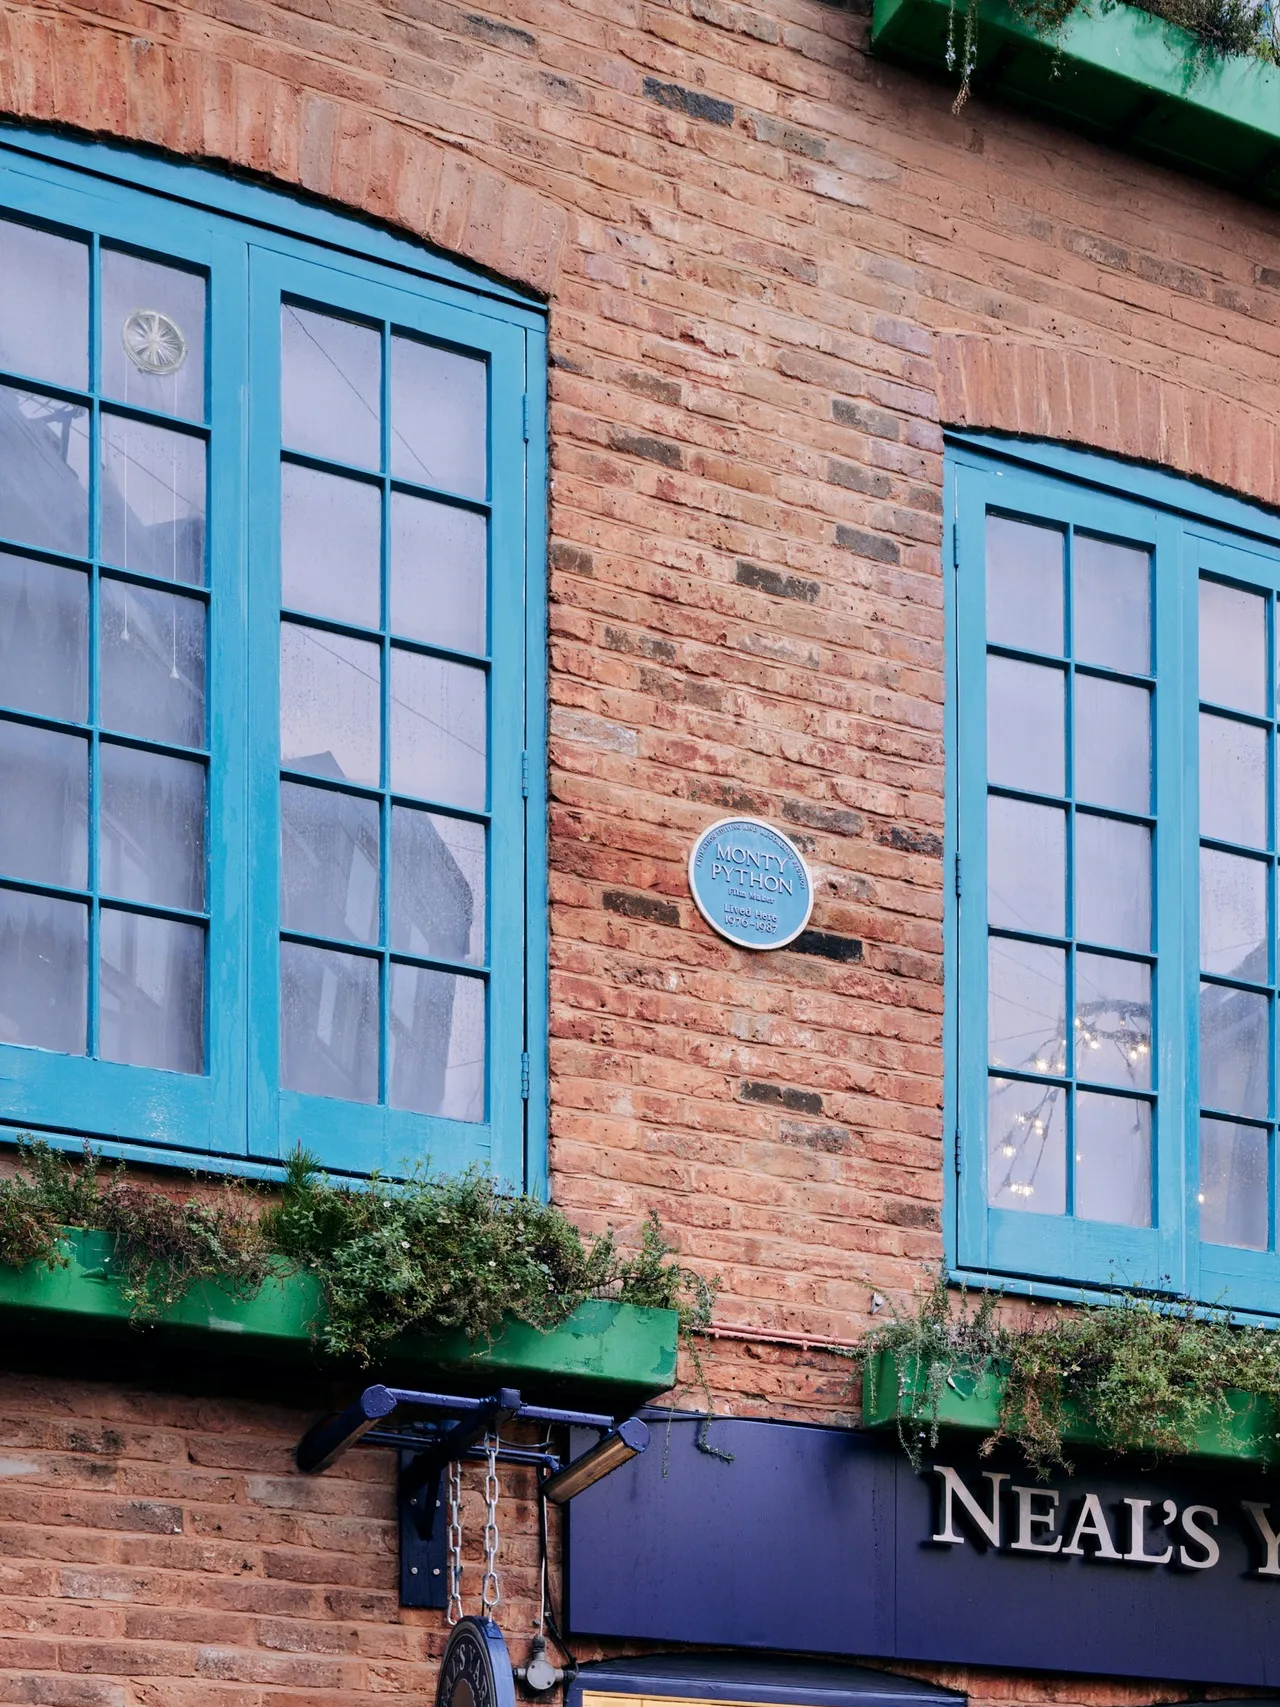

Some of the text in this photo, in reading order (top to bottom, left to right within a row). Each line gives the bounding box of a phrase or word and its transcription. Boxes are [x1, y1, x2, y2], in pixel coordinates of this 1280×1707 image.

[715, 843, 789, 874] MONTY
[711, 863, 793, 896] PYTHON
[728, 887, 747, 899] Film
[723, 903, 778, 923] Lived Here
[931, 1464, 1221, 1570] NEAL'S
